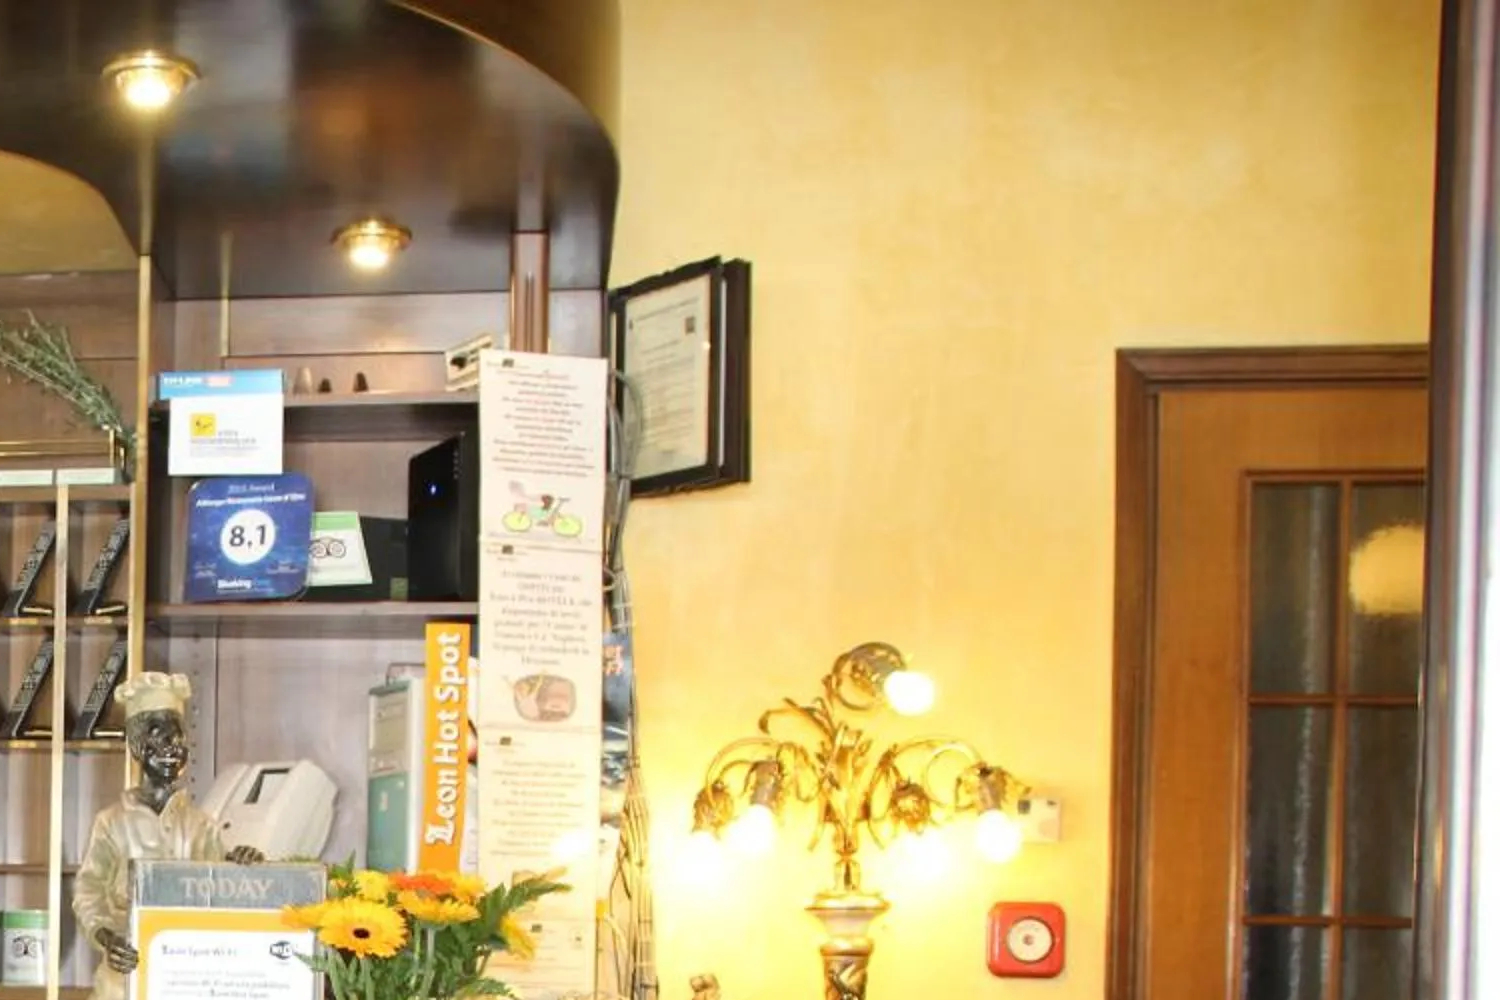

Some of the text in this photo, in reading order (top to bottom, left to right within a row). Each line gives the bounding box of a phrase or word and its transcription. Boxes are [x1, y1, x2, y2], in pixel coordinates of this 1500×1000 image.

[229, 524, 267, 550] 8,1
[425, 631, 466, 845] Leon Hot Spot
[179, 876, 274, 899] TODAY
